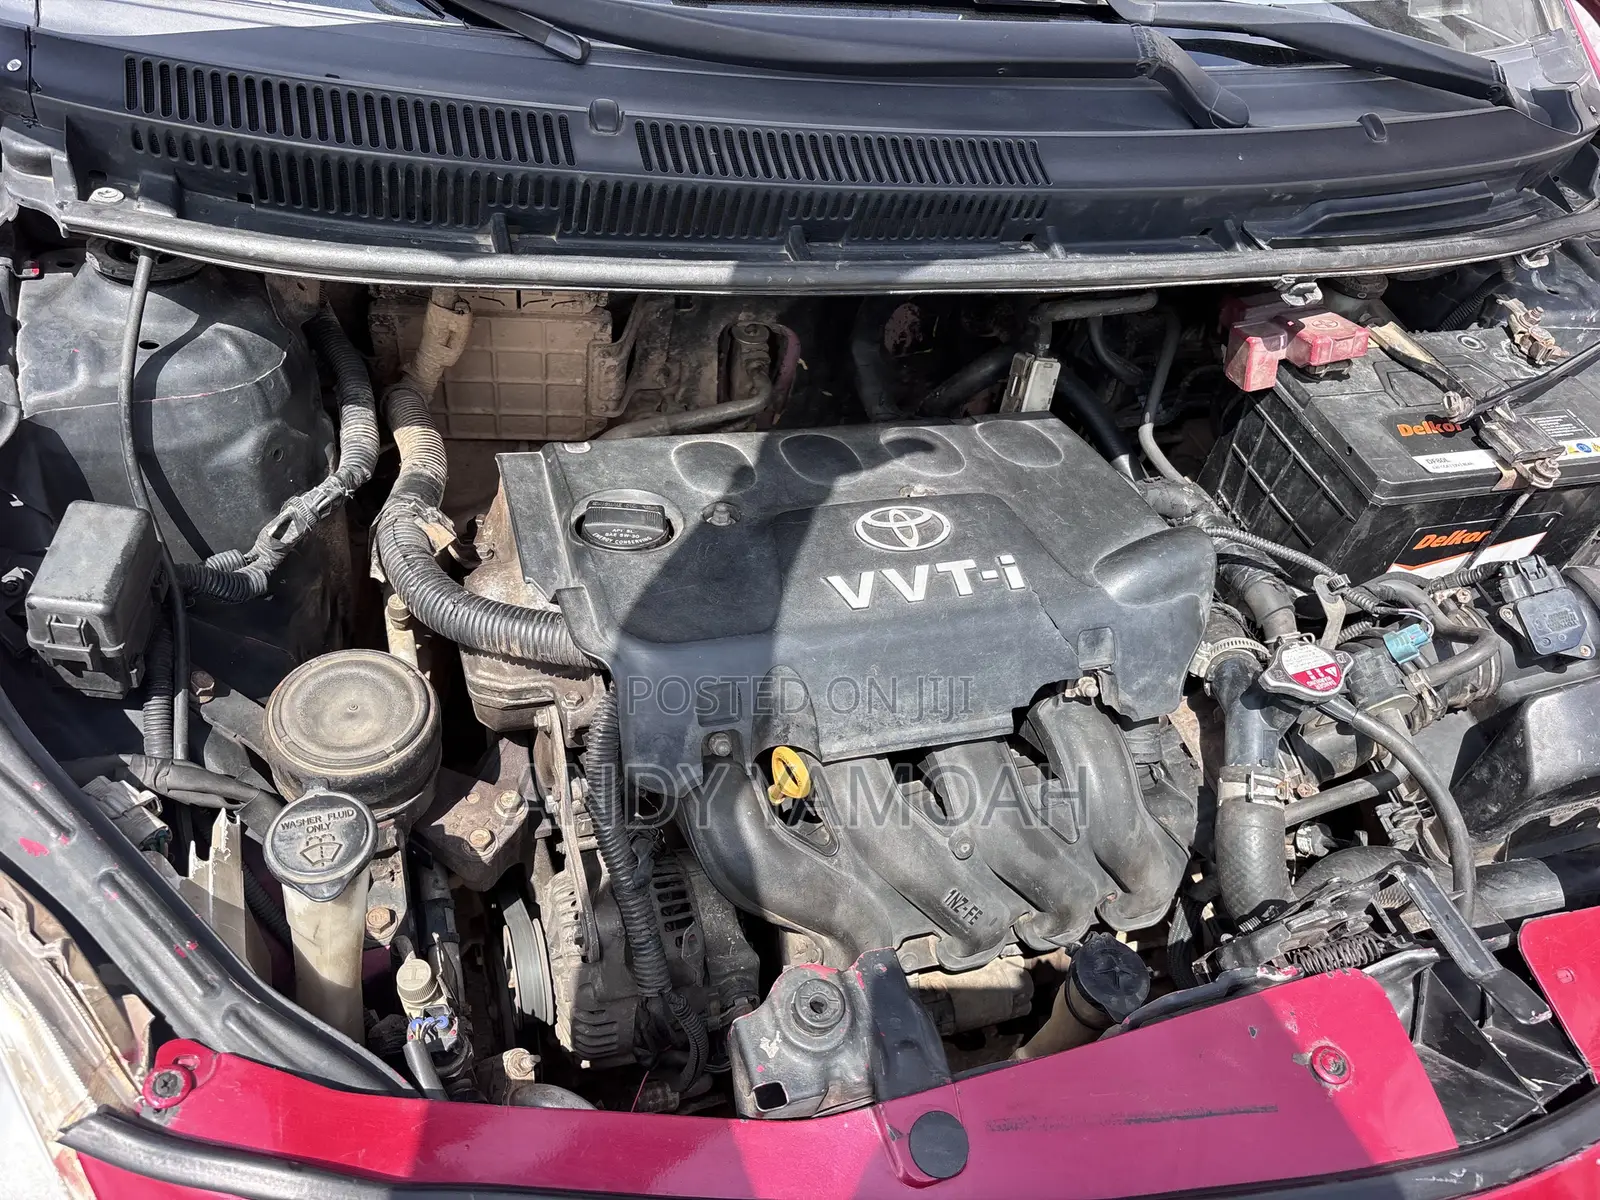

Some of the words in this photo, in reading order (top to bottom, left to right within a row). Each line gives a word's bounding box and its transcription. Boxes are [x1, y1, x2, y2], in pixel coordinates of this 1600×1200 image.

[1412, 529, 1492, 551] Delkor
[821, 554, 1026, 611] VVT-i
[280, 815, 322, 831] WASHER
[327, 808, 355, 821] FLUID
[306, 822, 332, 834] ONLY
[944, 889, 984, 926] 1NZ-FE
